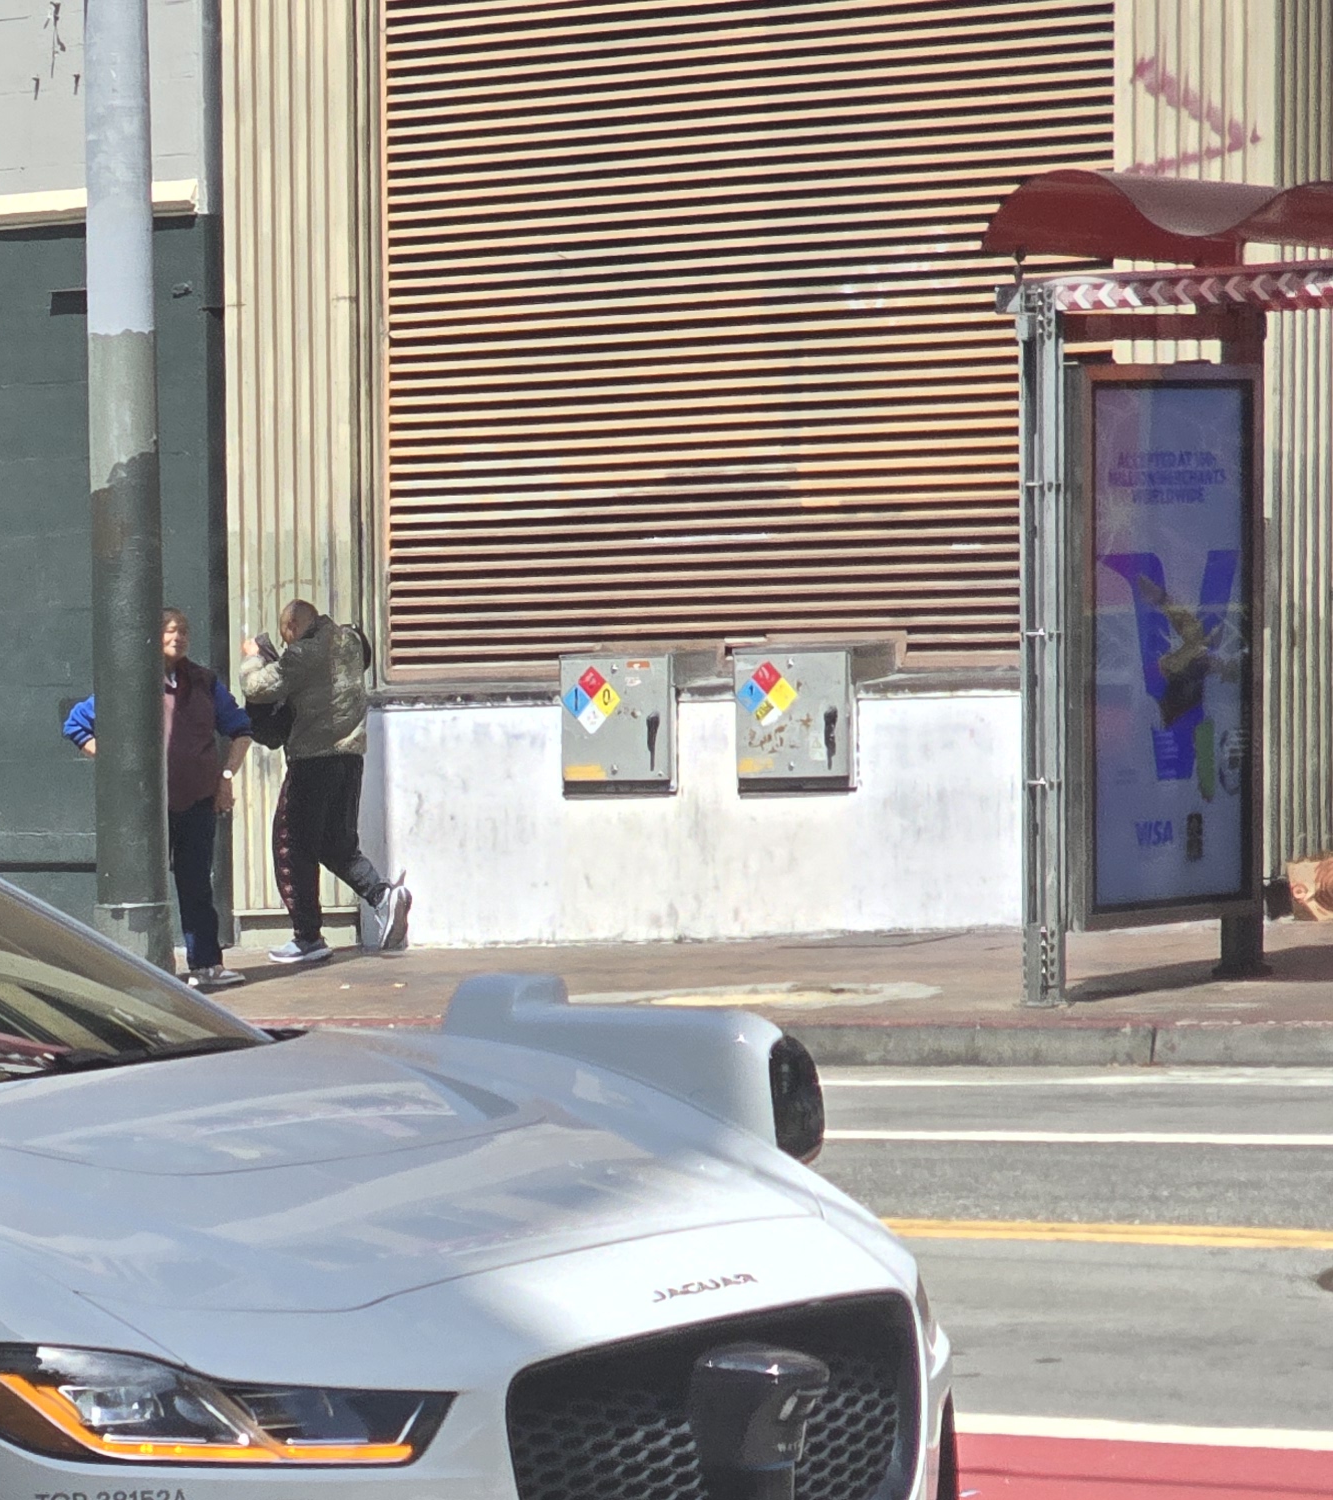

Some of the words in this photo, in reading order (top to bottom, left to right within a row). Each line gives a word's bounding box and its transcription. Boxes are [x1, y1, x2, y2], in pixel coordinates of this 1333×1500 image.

[602, 688, 611, 706] 0
[1135, 820, 1173, 846] VISA
[653, 1273, 758, 1303] JAGUAR
